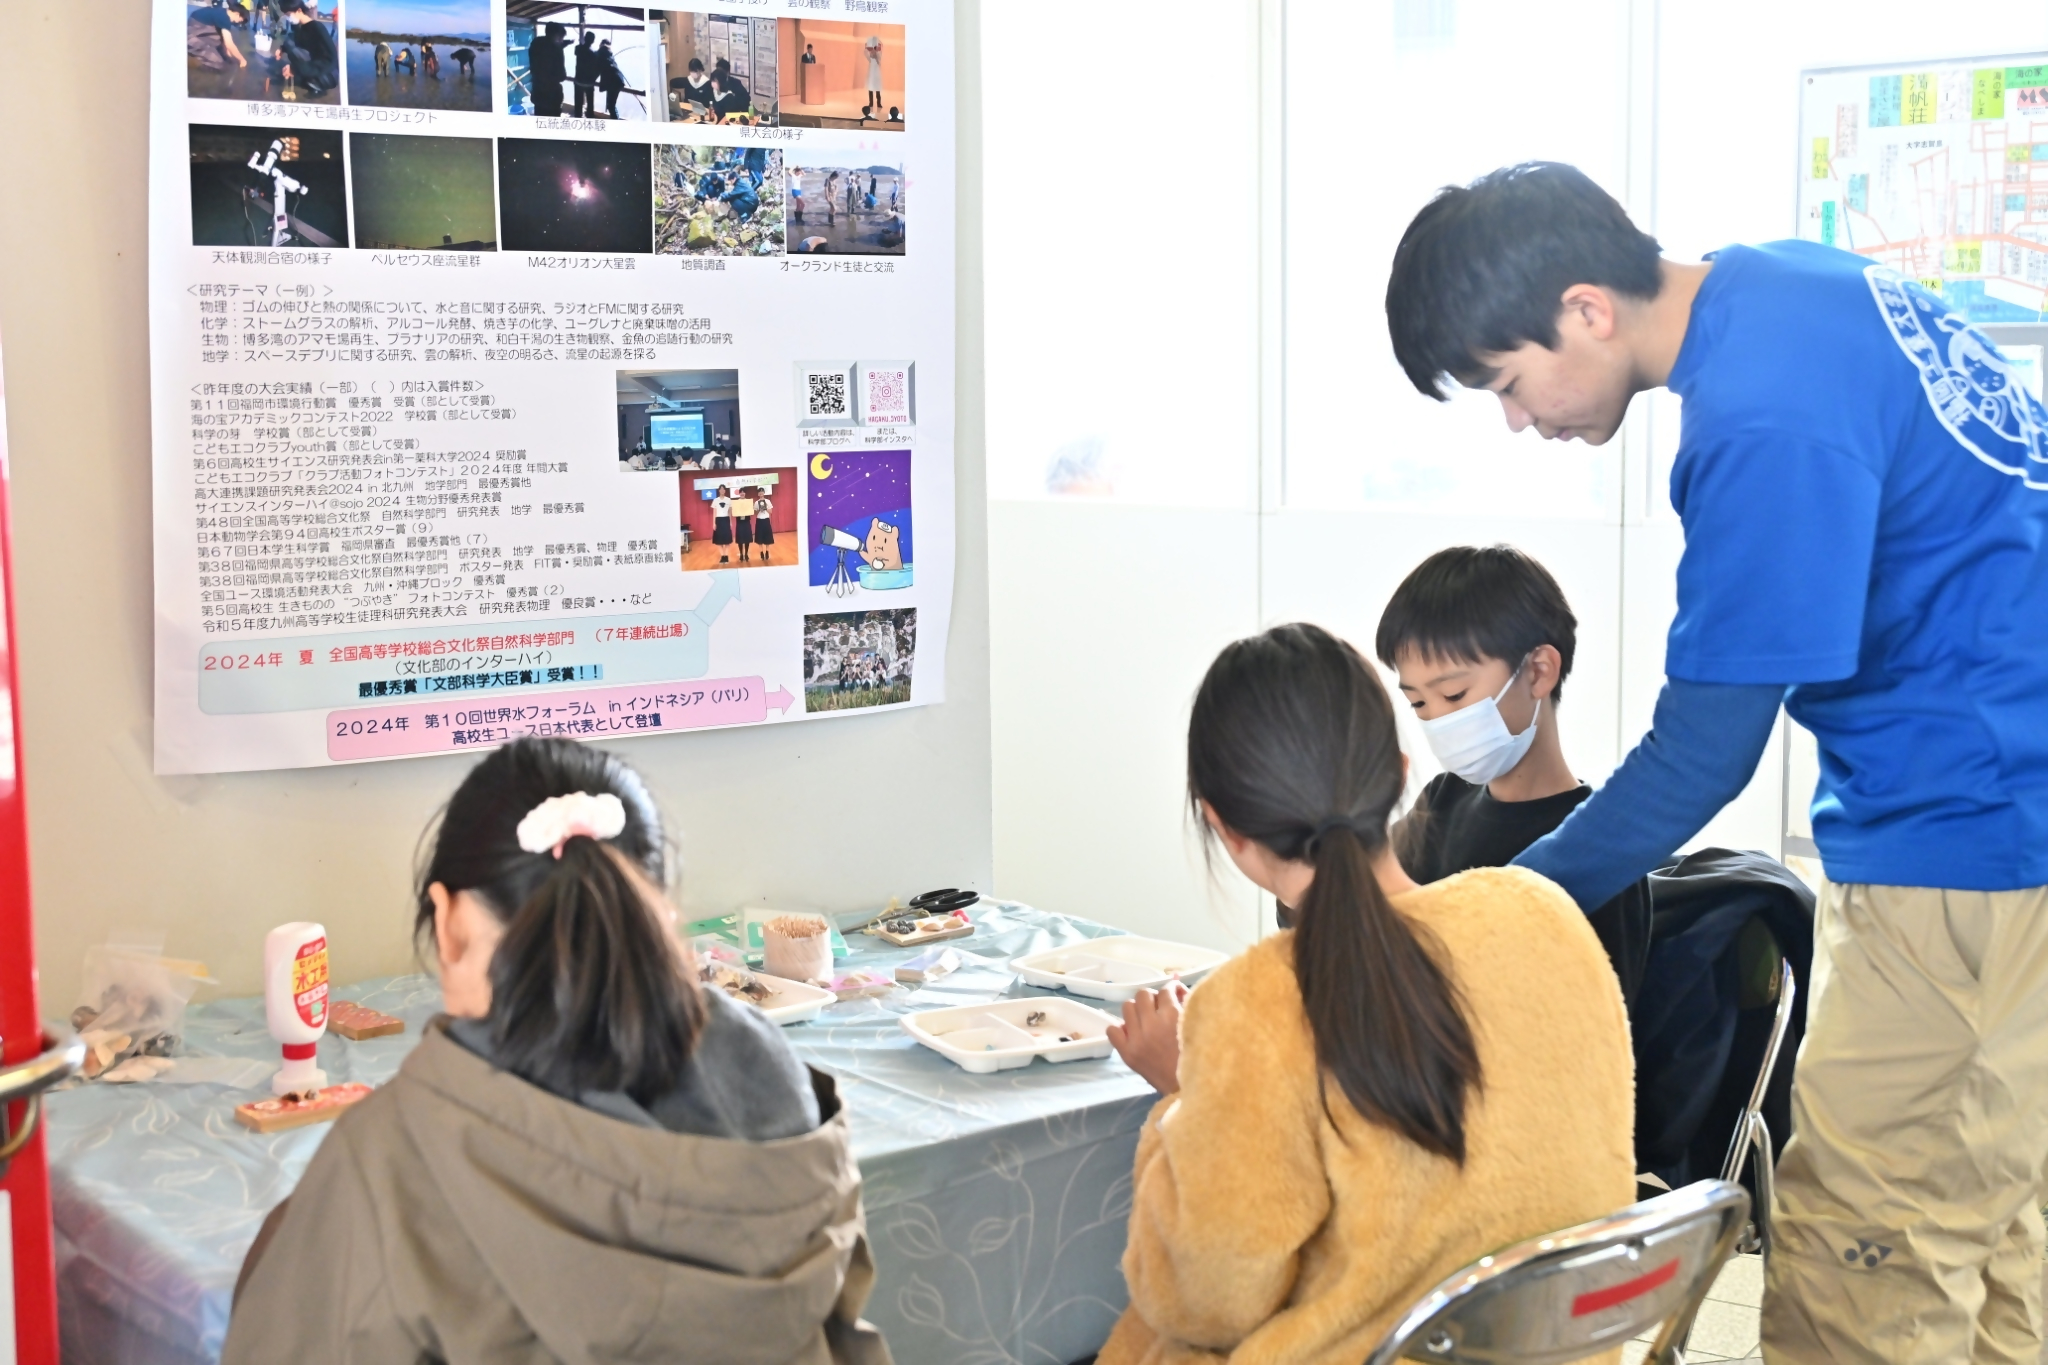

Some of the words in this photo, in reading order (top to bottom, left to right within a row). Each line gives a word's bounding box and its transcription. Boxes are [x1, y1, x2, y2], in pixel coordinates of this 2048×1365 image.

[535, 118, 606, 132] 伝統漁の体験
[739, 127, 804, 141] 県大会の様子
[212, 250, 332, 265] 天体観測合宿の様子
[371, 252, 481, 268] ペルセウス座流星群
[528, 256, 636, 270] M42オリオン大星雲
[681, 258, 726, 272] 地質調査
[780, 260, 895, 274] オークランド生徒と交流
[349, 396, 382, 409] 優秀賞
[192, 428, 240, 440] 科学の芽
[527, 462, 568, 475] 年間大賞
[368, 482, 378, 494] in
[382, 481, 414, 493] 北九州
[425, 479, 467, 492] 地学部門
[478, 477, 532, 490] 最優秀賞他
[367, 495, 400, 508] 2024
[406, 492, 502, 507] 生物分野優秀発表賞
[382, 508, 446, 521] 自然科学部門
[457, 506, 500, 519] 研究発表
[511, 504, 532, 517] 地学
[543, 502, 585, 516] 最優秀賞
[342, 538, 395, 552] 福岡県審査
[458, 547, 502, 560] 研究発表
[512, 545, 534, 558] 地学
[628, 539, 658, 552] 優秀賞
[460, 559, 524, 574] ポスター発表
[474, 574, 506, 587] 優秀賞
[479, 599, 550, 615] 研究発表物理
[204, 652, 283, 671] 2024年
[299, 649, 314, 665] 夏
[329, 631, 575, 663] 全国高等学校総合文化祭自然科学部門
[336, 717, 410, 737] 2024年
[424, 701, 596, 729] 第10回世界水フォーラム
[608, 700, 621, 712] in
